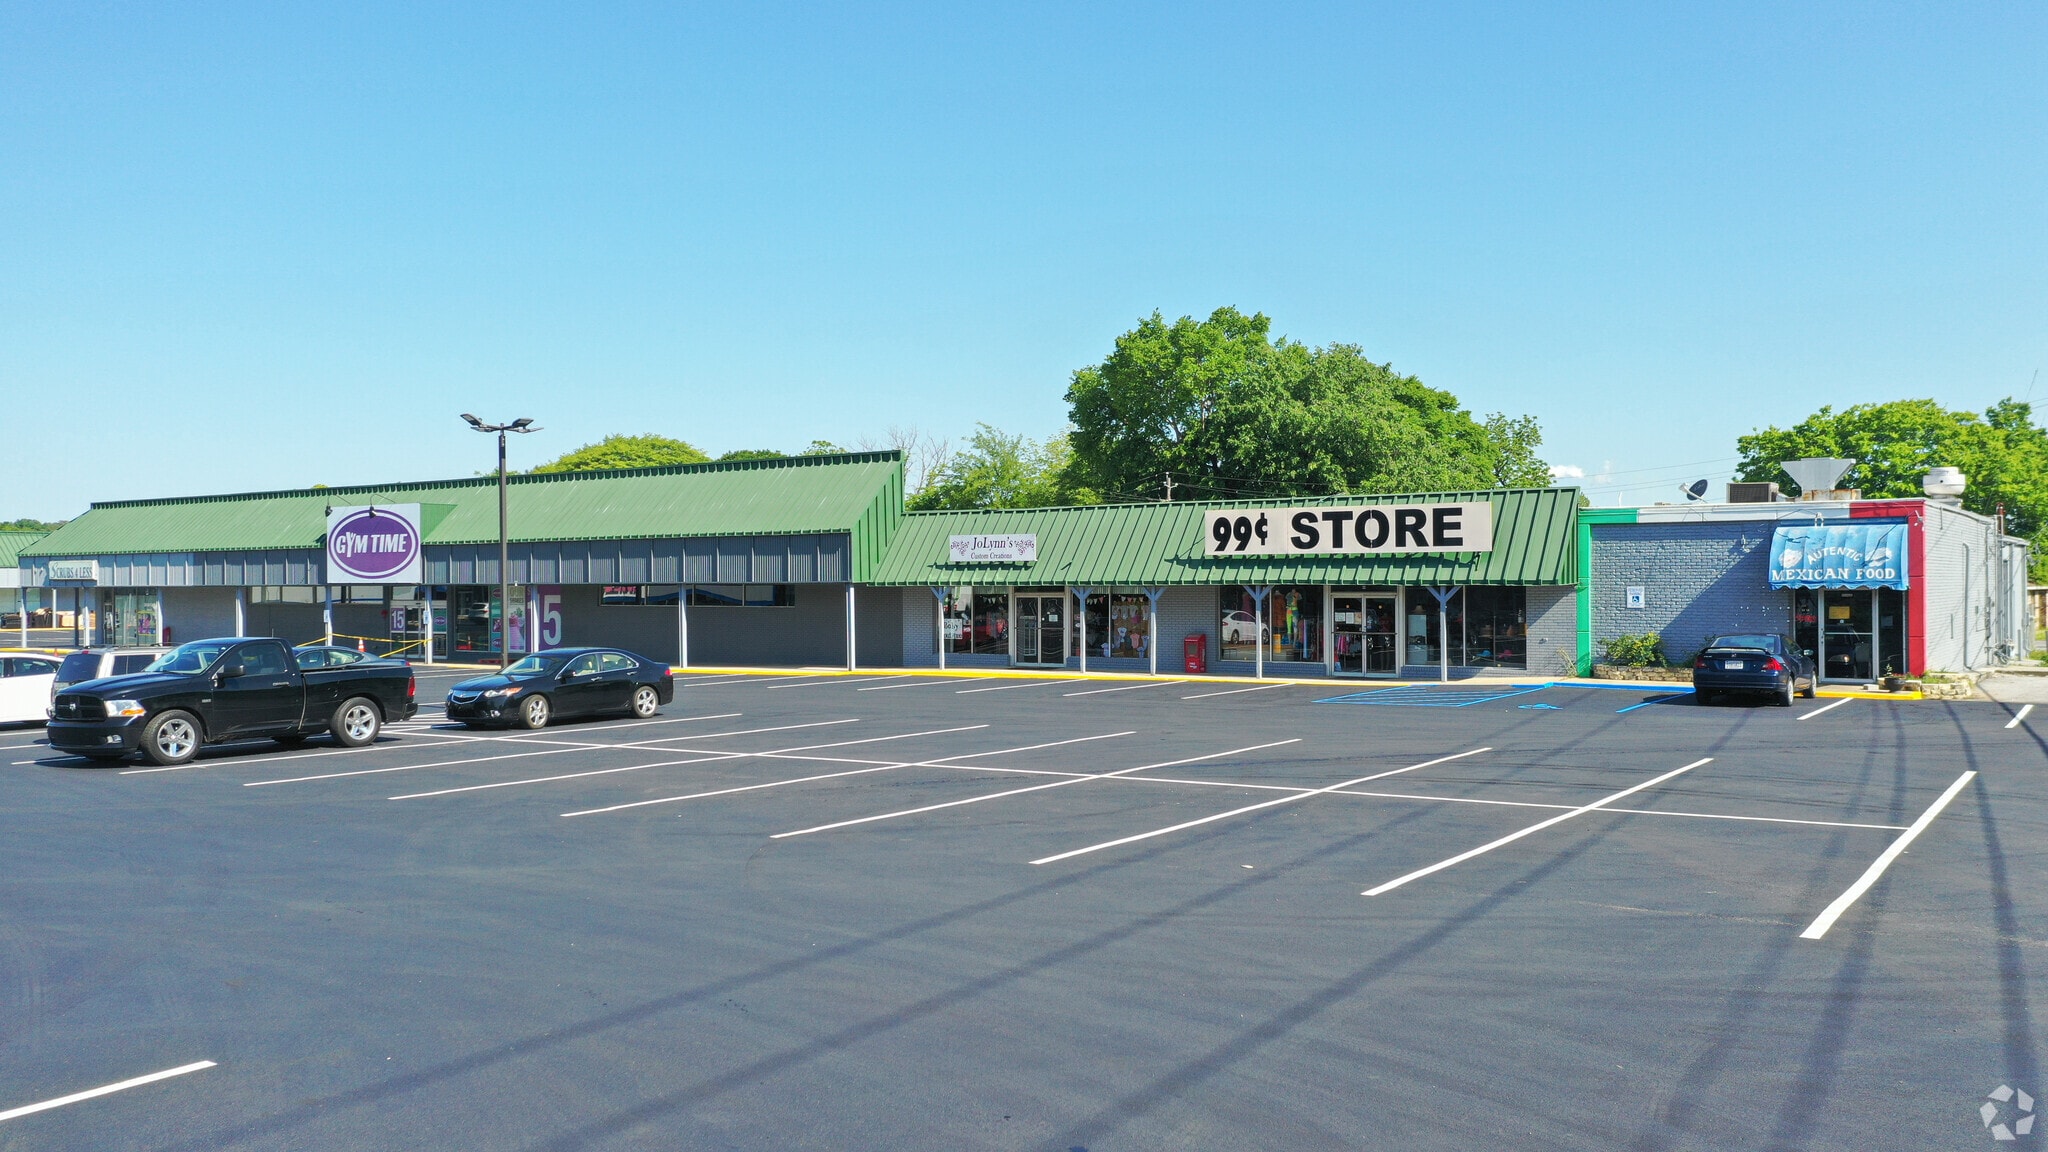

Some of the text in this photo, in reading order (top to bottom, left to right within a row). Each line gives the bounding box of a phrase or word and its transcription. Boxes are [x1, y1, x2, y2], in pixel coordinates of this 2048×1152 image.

[1212, 507, 1464, 551] 99¢ STORE
[336, 531, 408, 558] GYM TIME
[971, 536, 1014, 551] JoLynn's
[971, 552, 1012, 560] Custom Creations
[1807, 546, 1863, 565] AUTENTIC
[75, 568, 79, 578] 4
[80, 567, 93, 578] LESS
[1771, 568, 1896, 581] MEXICAN FOOD
[391, 610, 405, 629] 15
